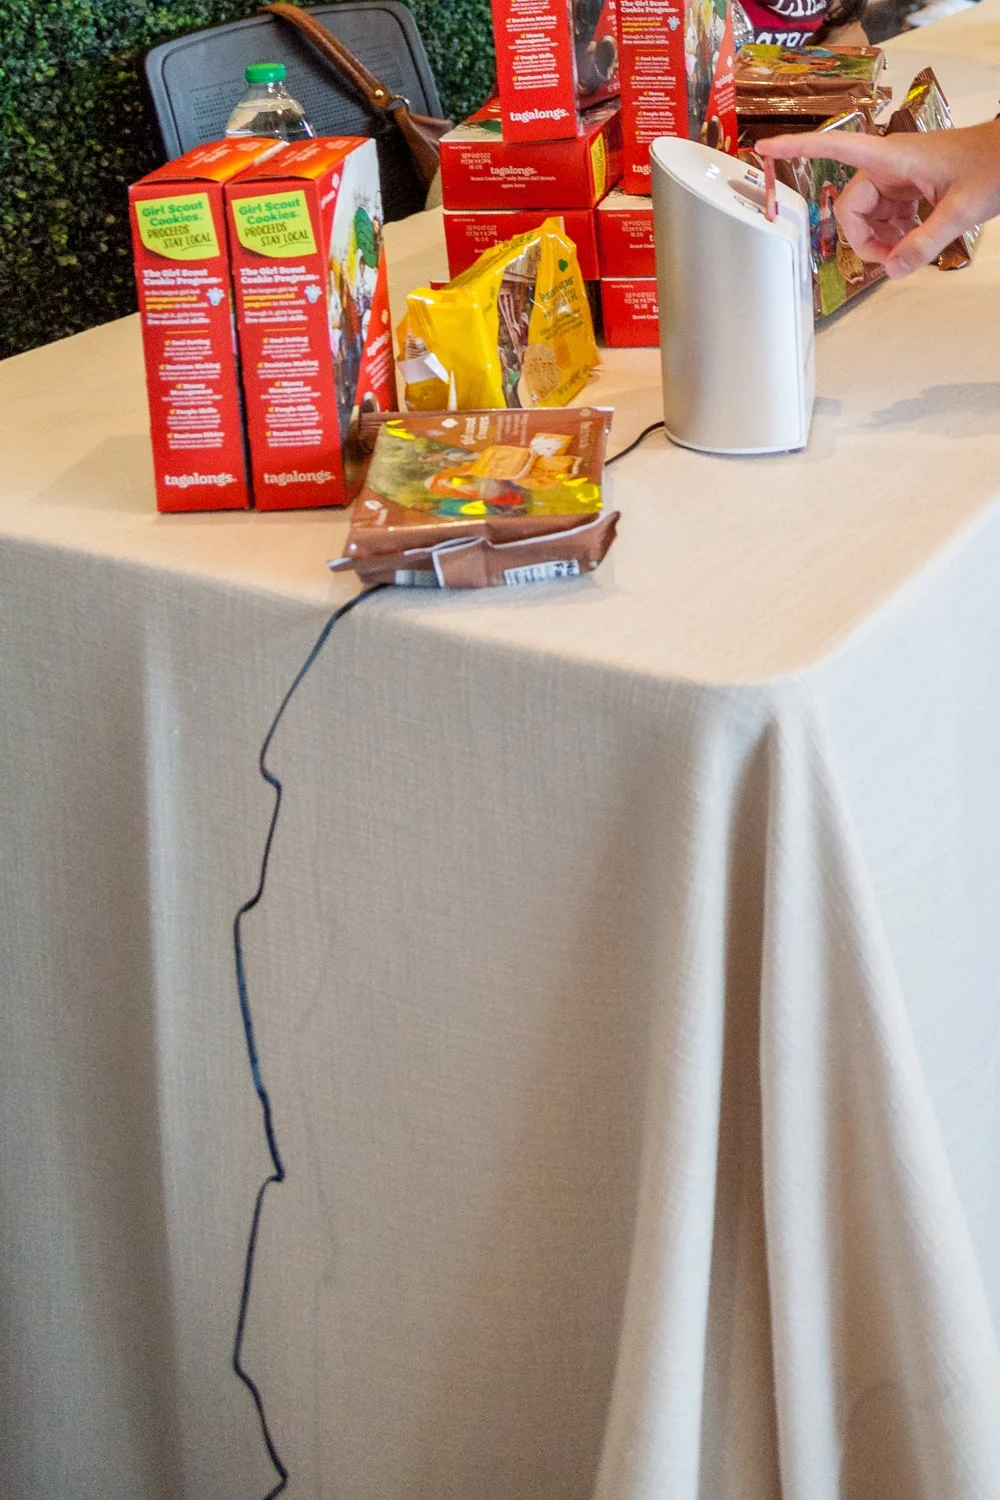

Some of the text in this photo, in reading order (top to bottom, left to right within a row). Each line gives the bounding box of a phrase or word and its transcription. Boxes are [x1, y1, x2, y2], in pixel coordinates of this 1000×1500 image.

[142, 201, 203, 217] Girl Scout
[239, 199, 300, 215] Girl Scout
[149, 213, 198, 227] Cookies
[247, 211, 297, 225] Cookies
[147, 224, 190, 239] PROCEEDS
[244, 222, 288, 237] PROCEEDS
[162, 232, 212, 249] STAY LOCAL
[260, 229, 310, 247] STAY LOCAL
